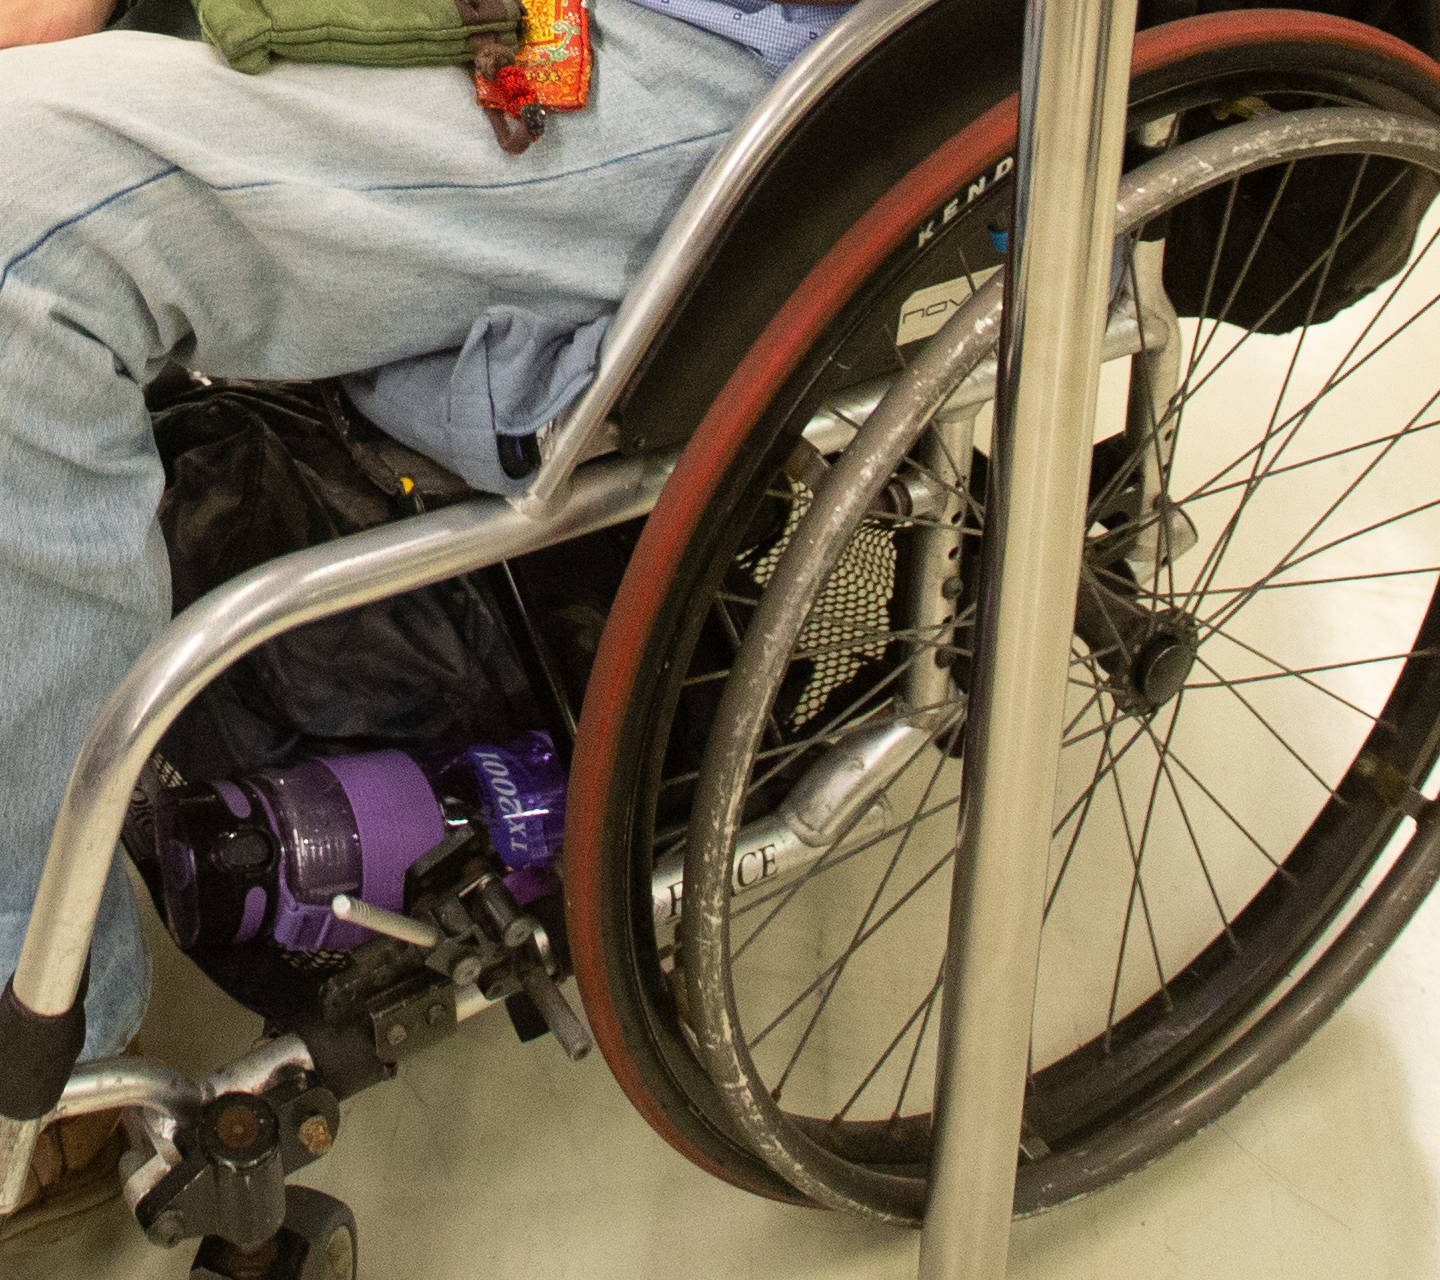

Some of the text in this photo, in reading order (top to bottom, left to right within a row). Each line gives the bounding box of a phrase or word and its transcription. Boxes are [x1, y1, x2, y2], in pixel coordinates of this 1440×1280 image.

[917, 156, 1014, 248] KEND
[902, 292, 970, 325] nov
[667, 843, 777, 917] FCE
